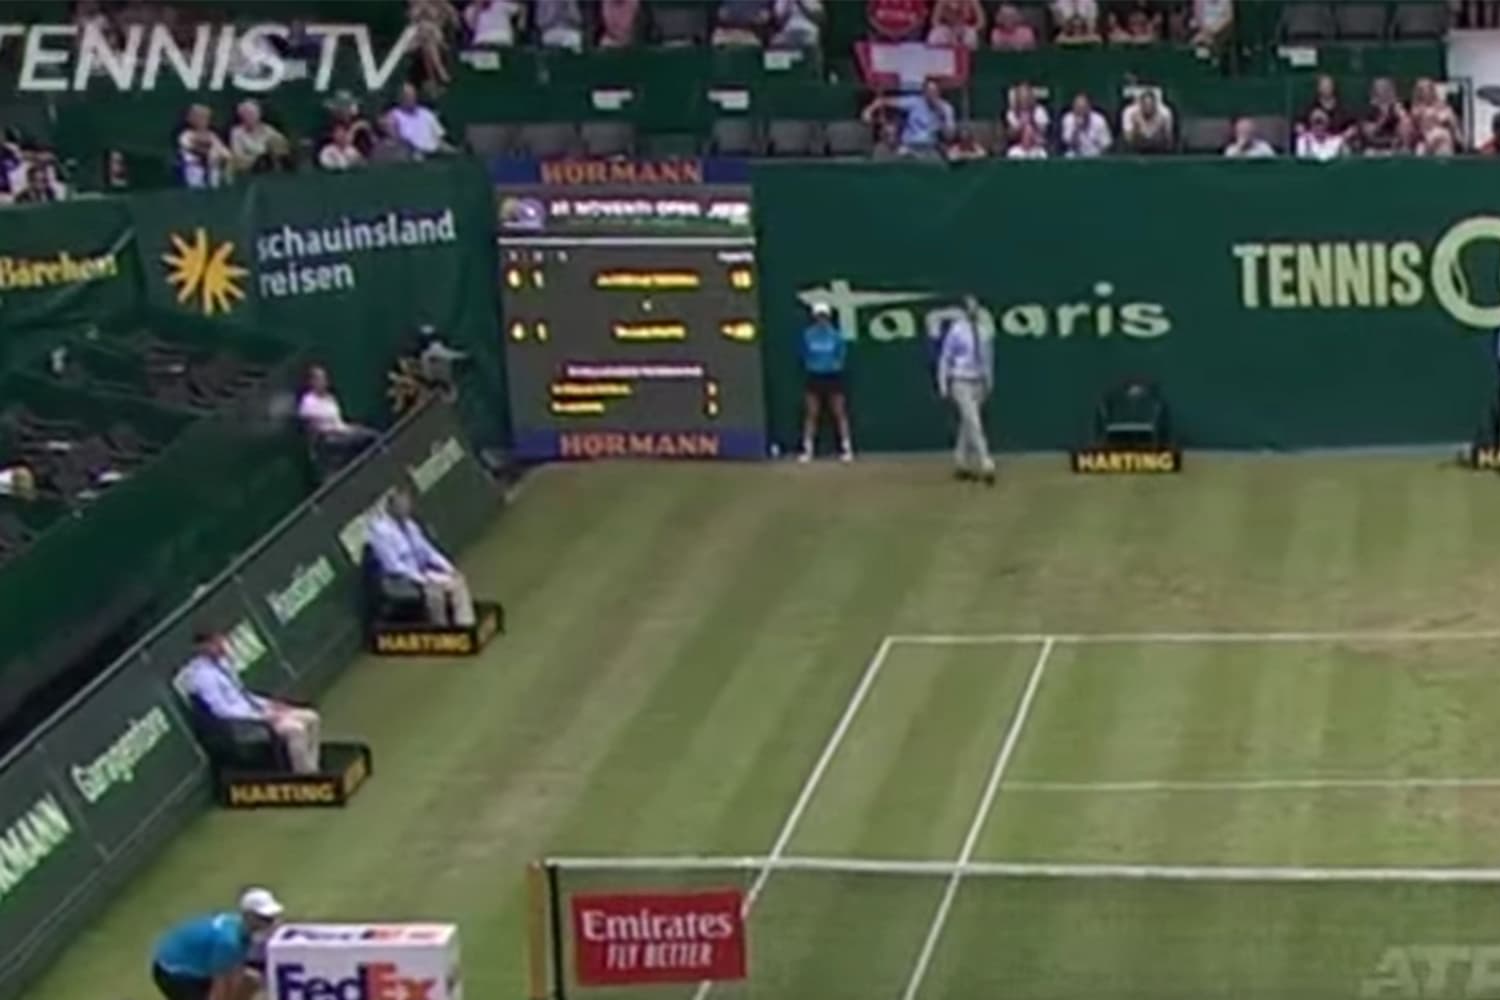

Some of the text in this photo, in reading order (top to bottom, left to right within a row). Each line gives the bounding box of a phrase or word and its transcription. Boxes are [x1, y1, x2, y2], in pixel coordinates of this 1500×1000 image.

[256, 207, 456, 262] schauinsland
[259, 262, 355, 297] reisen
[1233, 239, 1425, 308] TENNIS
[1077, 450, 1175, 473] HARTING
[376, 632, 472, 652] HARTING
[229, 783, 337, 803] HARTING
[581, 907, 734, 942] Emirates
[606, 941, 713, 969] FLY BETTER
